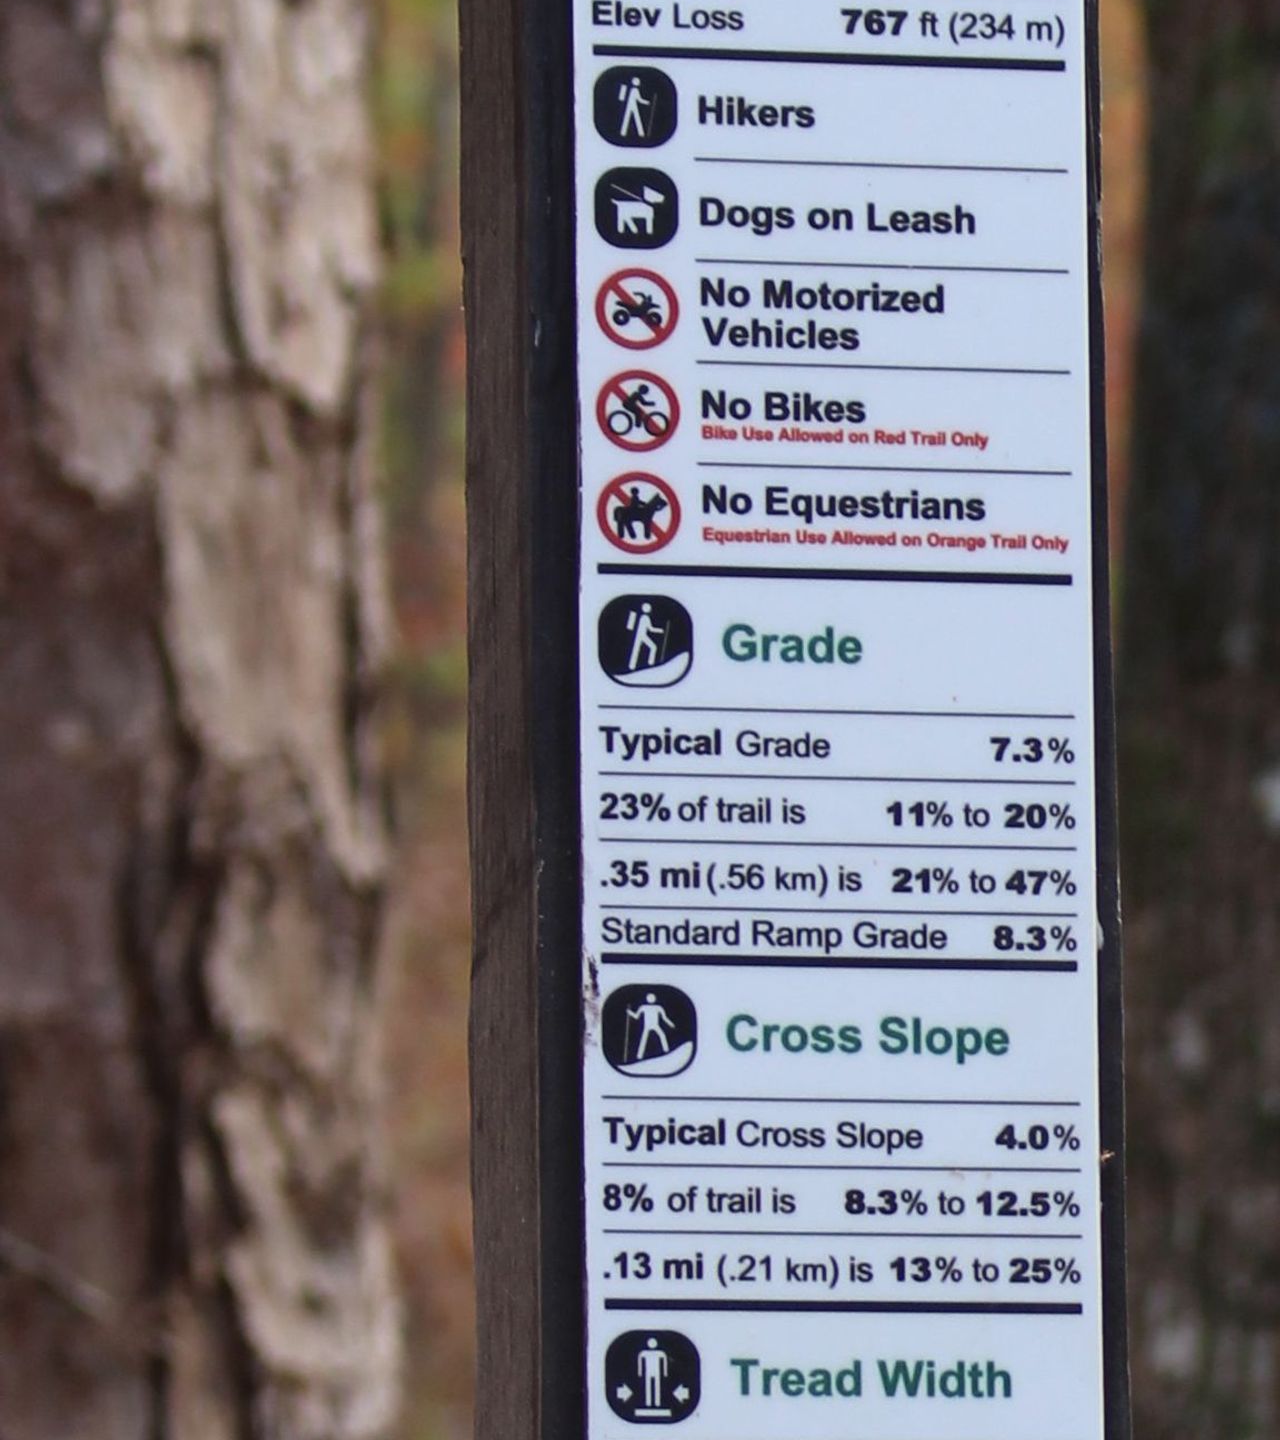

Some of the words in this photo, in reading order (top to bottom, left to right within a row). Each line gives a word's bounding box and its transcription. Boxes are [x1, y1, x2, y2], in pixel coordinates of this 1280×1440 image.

[591, 0, 662, 28] Elev
[672, 2, 745, 32] Loss
[840, 8, 909, 37] 767
[918, 10, 940, 38] ft
[948, 11, 1016, 46] (234
[1026, 14, 1065, 49] m)
[697, 94, 816, 129] Hikers
[699, 196, 796, 237] Dogs
[806, 207, 854, 232] on
[866, 202, 976, 235] Leash
[700, 276, 751, 309] No
[762, 278, 945, 314] Motorized
[701, 316, 861, 351] Vehicles
[701, 389, 752, 421] No
[764, 391, 867, 424] Bikes
[701, 424, 739, 441] Bike
[741, 425, 775, 442] Use
[777, 426, 845, 444] Allowed
[847, 431, 870, 445] on
[873, 429, 907, 446] Red
[910, 430, 947, 447] Trail
[950, 431, 989, 452] Only
[701, 483, 753, 516] No
[765, 485, 987, 522] Equestrians
[702, 526, 792, 546] Equestrian
[795, 529, 828, 545] Use
[830, 530, 898, 547] Allowed
[900, 534, 923, 548] on
[926, 532, 987, 553] Orange
[990, 533, 1028, 550] Trail
[1030, 534, 1070, 555] Only
[721, 622, 863, 665] Grade
[597, 725, 722, 762] Typical
[735, 729, 831, 760] Grade
[989, 736, 1076, 765] 7.3%
[599, 791, 672, 823] 23%
[677, 794, 709, 823] of
[715, 796, 772, 824] trail
[781, 797, 807, 825] is
[886, 800, 954, 828] 11%
[962, 803, 991, 828] to
[1003, 802, 1077, 830] 20%
[600, 859, 650, 889] .35
[660, 861, 701, 890] mi
[706, 862, 765, 897] (.56
[774, 864, 829, 899] km)
[838, 865, 863, 893] is
[891, 867, 960, 895] 21%
[968, 869, 997, 895] to
[1004, 869, 1078, 897] 47%
[601, 916, 741, 947] Standard
[751, 919, 843, 955] Ramp
[852, 920, 948, 951] Grade
[993, 924, 1078, 953] 8.3%
[725, 1013, 863, 1055] Cross
[878, 1015, 1011, 1066] Slope
[601, 1116, 727, 1151] Typical
[735, 1119, 827, 1149] Cross
[836, 1120, 924, 1153] Slope
[994, 1123, 1081, 1152] 4.0%
[602, 1182, 655, 1213] 8%
[666, 1185, 699, 1214] of
[705, 1186, 762, 1214] trail
[771, 1187, 797, 1215] is
[844, 1188, 929, 1217] 8.3%
[937, 1191, 966, 1216] to
[975, 1190, 1081, 1218] 12.5%
[603, 1251, 653, 1281] .13
[662, 1251, 704, 1281] mi
[716, 1253, 772, 1287] (.21
[785, 1255, 840, 1288] km)
[849, 1255, 874, 1284] is
[889, 1256, 964, 1284] 13%
[971, 1258, 1000, 1284] to
[1008, 1257, 1082, 1285] 25%
[729, 1357, 863, 1398] Tread
[876, 1359, 1013, 1399] Width
